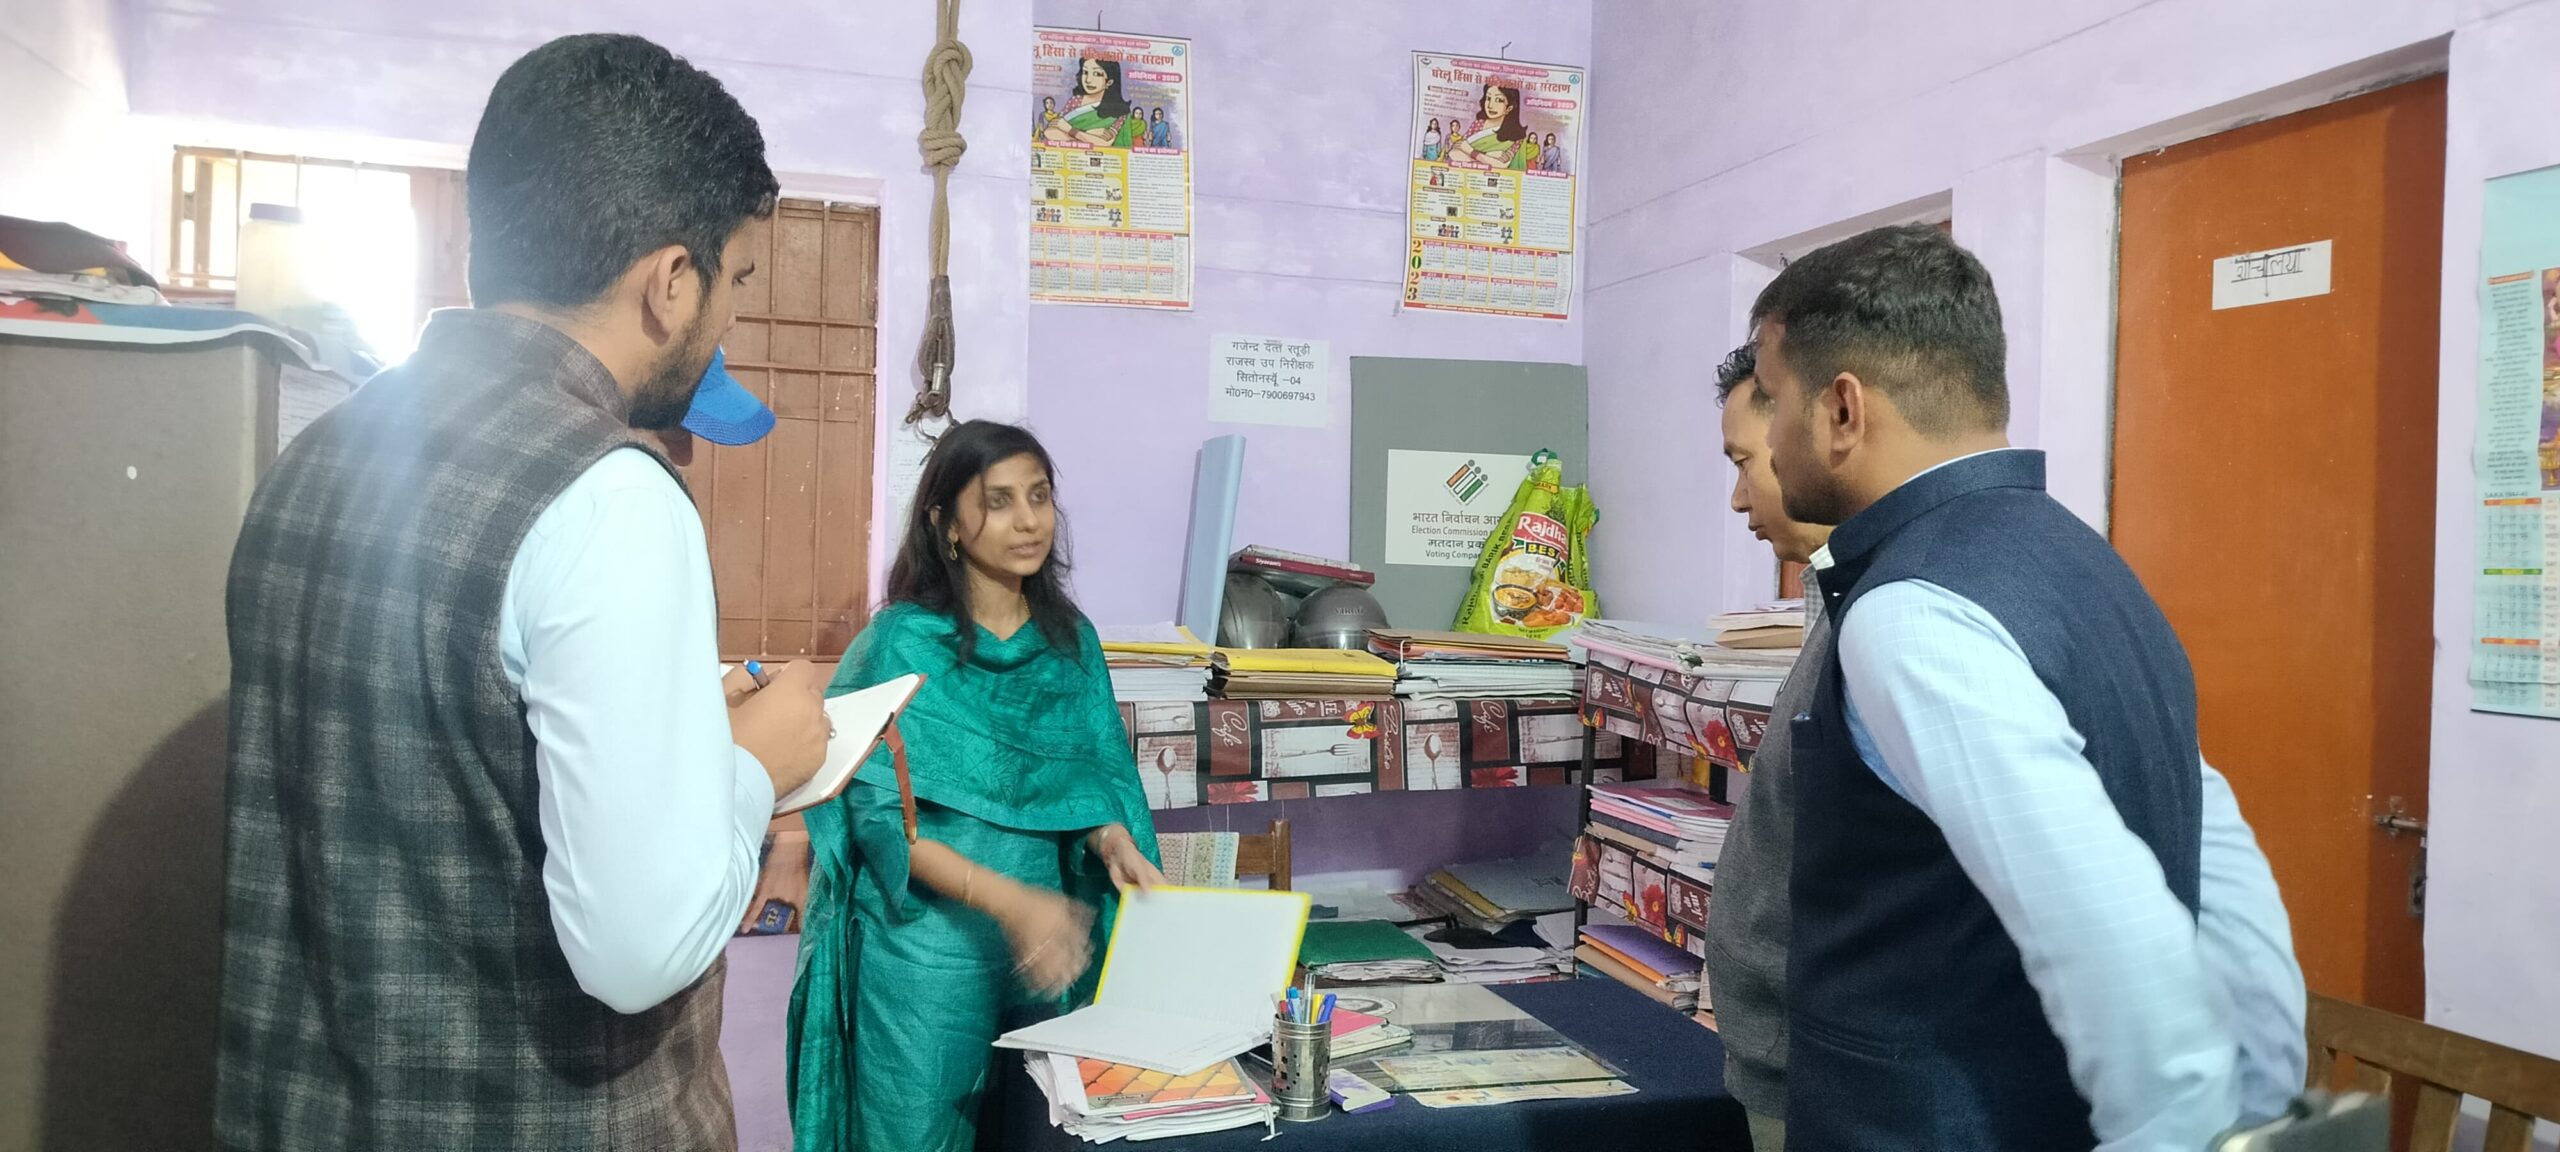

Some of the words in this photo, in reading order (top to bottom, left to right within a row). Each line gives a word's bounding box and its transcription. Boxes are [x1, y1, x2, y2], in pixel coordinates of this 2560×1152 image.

[1043, 44, 1065, 57] हिंसा
[1068, 46, 1076, 57] से
[1127, 51, 1138, 63] का
[1432, 67, 1453, 84] घरेलू
[1454, 69, 1473, 83] हिंसा
[1475, 72, 1483, 84] से
[1525, 80, 1537, 91] का
[1232, 340, 1259, 352] गजेन्द्र
[1225, 356, 1256, 367] राजस्व
[1260, 358, 1275, 368] उप
[1280, 357, 1315, 370] निरीक्षक
[1412, 512, 1439, 523] भारत
[1441, 510, 1480, 524] निर्वाचन
[1412, 525, 1441, 535] Election
[1443, 526, 1488, 537] Commission
[1518, 516, 1568, 545] Rajdha
[1427, 538, 1464, 549] मतदान
[1527, 543, 1558, 558] BES
[1425, 550, 1450, 560] Voting
